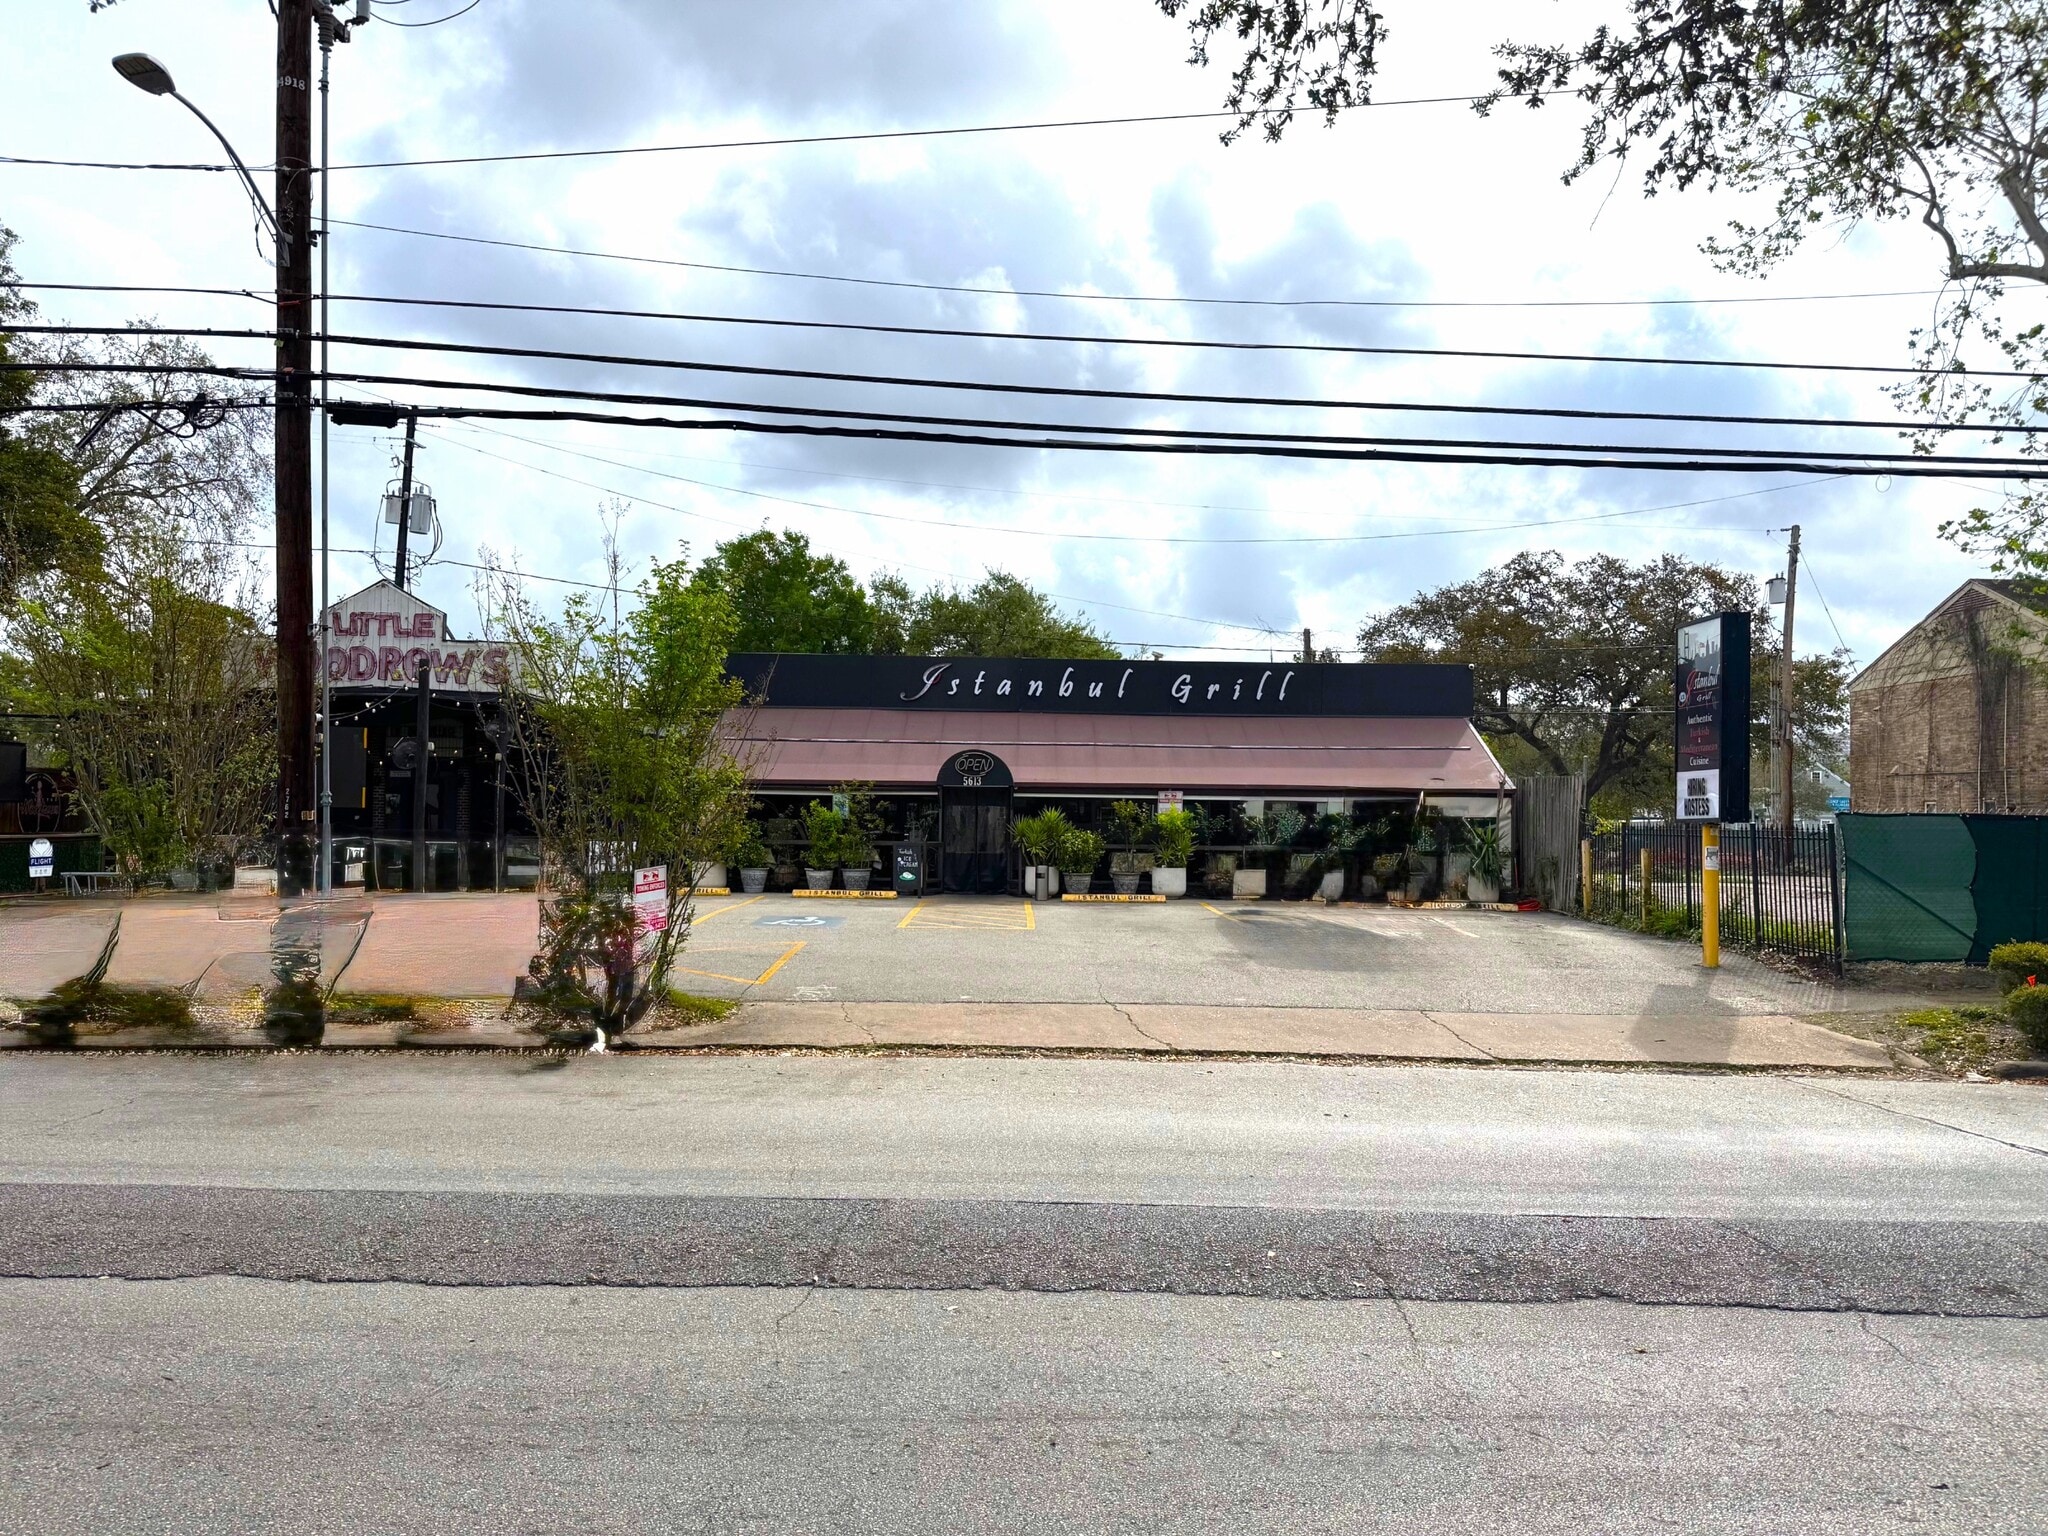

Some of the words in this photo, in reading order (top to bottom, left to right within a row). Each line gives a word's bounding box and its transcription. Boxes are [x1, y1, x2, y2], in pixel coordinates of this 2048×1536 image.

[332, 611, 436, 638] LITTLE
[900, 663, 1134, 701] Istanbul
[1171, 671, 1296, 704] Grill
[1696, 690, 1713, 702] Grill
[1686, 713, 1713, 725] Authentic
[1690, 726, 1710, 738] Turkish
[1680, 743, 1718, 754] Mediterranean
[957, 758, 991, 771] OPEN
[1689, 755, 1710, 766] Cuisine
[963, 776, 982, 786] 5613
[1687, 777, 1707, 797] HIRING
[1684, 797, 1710, 817] HOSTESS
[30, 857, 52, 866] FLIGHT
[808, 889, 853, 897] ISTANBUL
[858, 890, 884, 898] GRILL
